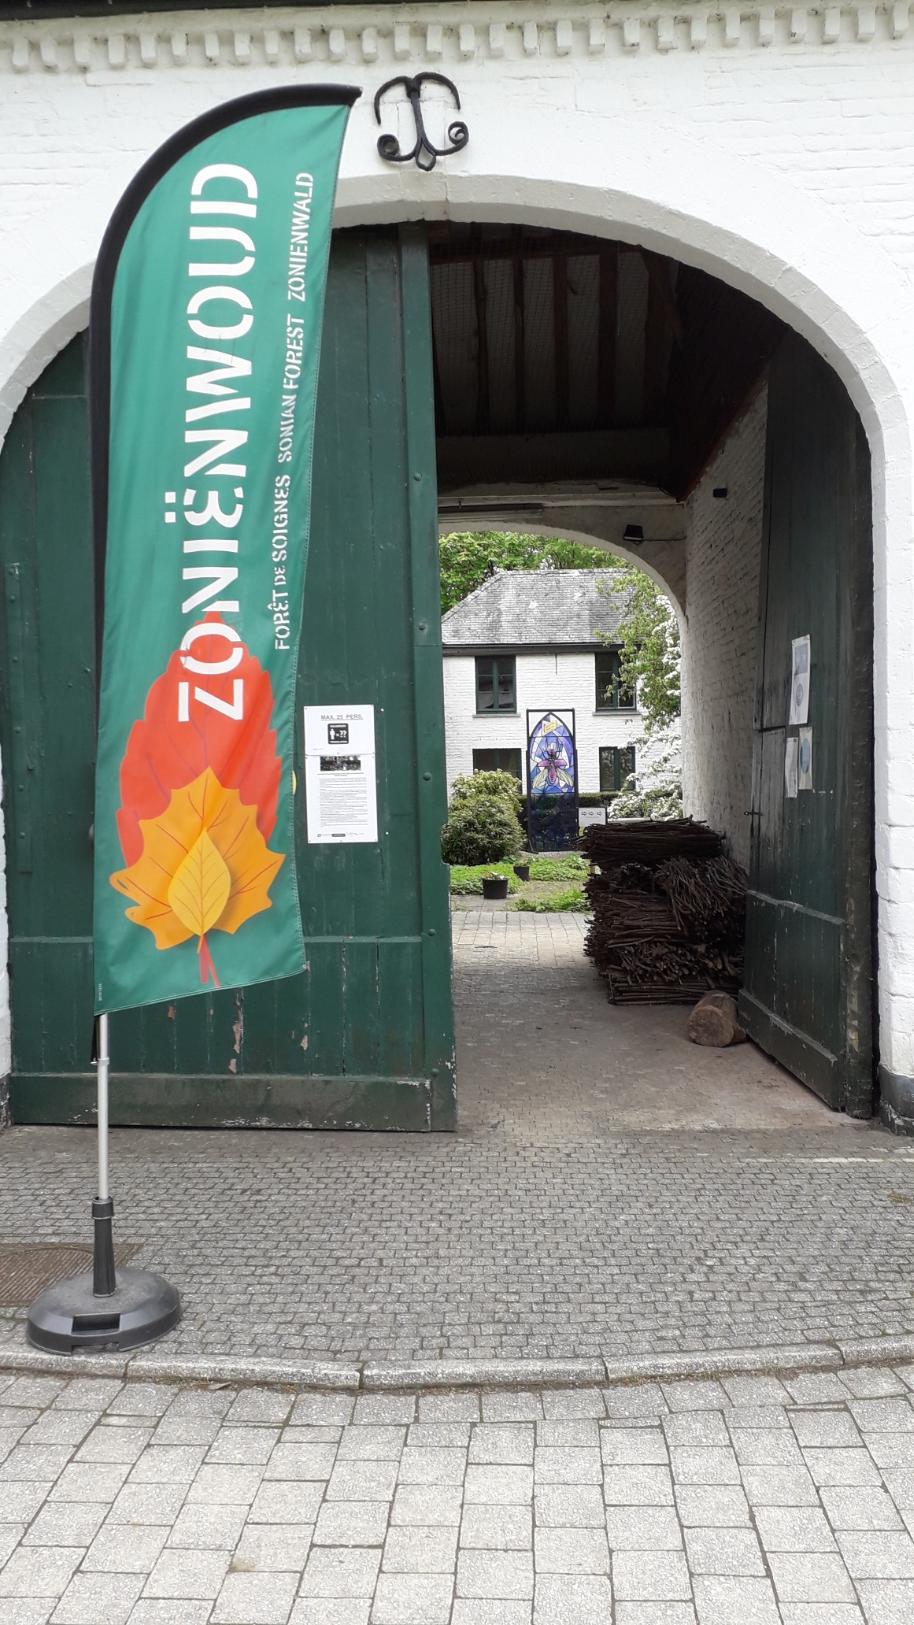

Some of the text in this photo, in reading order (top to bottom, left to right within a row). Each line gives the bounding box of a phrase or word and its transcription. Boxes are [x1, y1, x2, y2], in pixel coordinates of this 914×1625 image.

[163, 163, 259, 724] ZONIËNWOUD
[267, 172, 314, 650] FORÊT DE SOIGNES SONIAN FOREST ZONIENWALD
